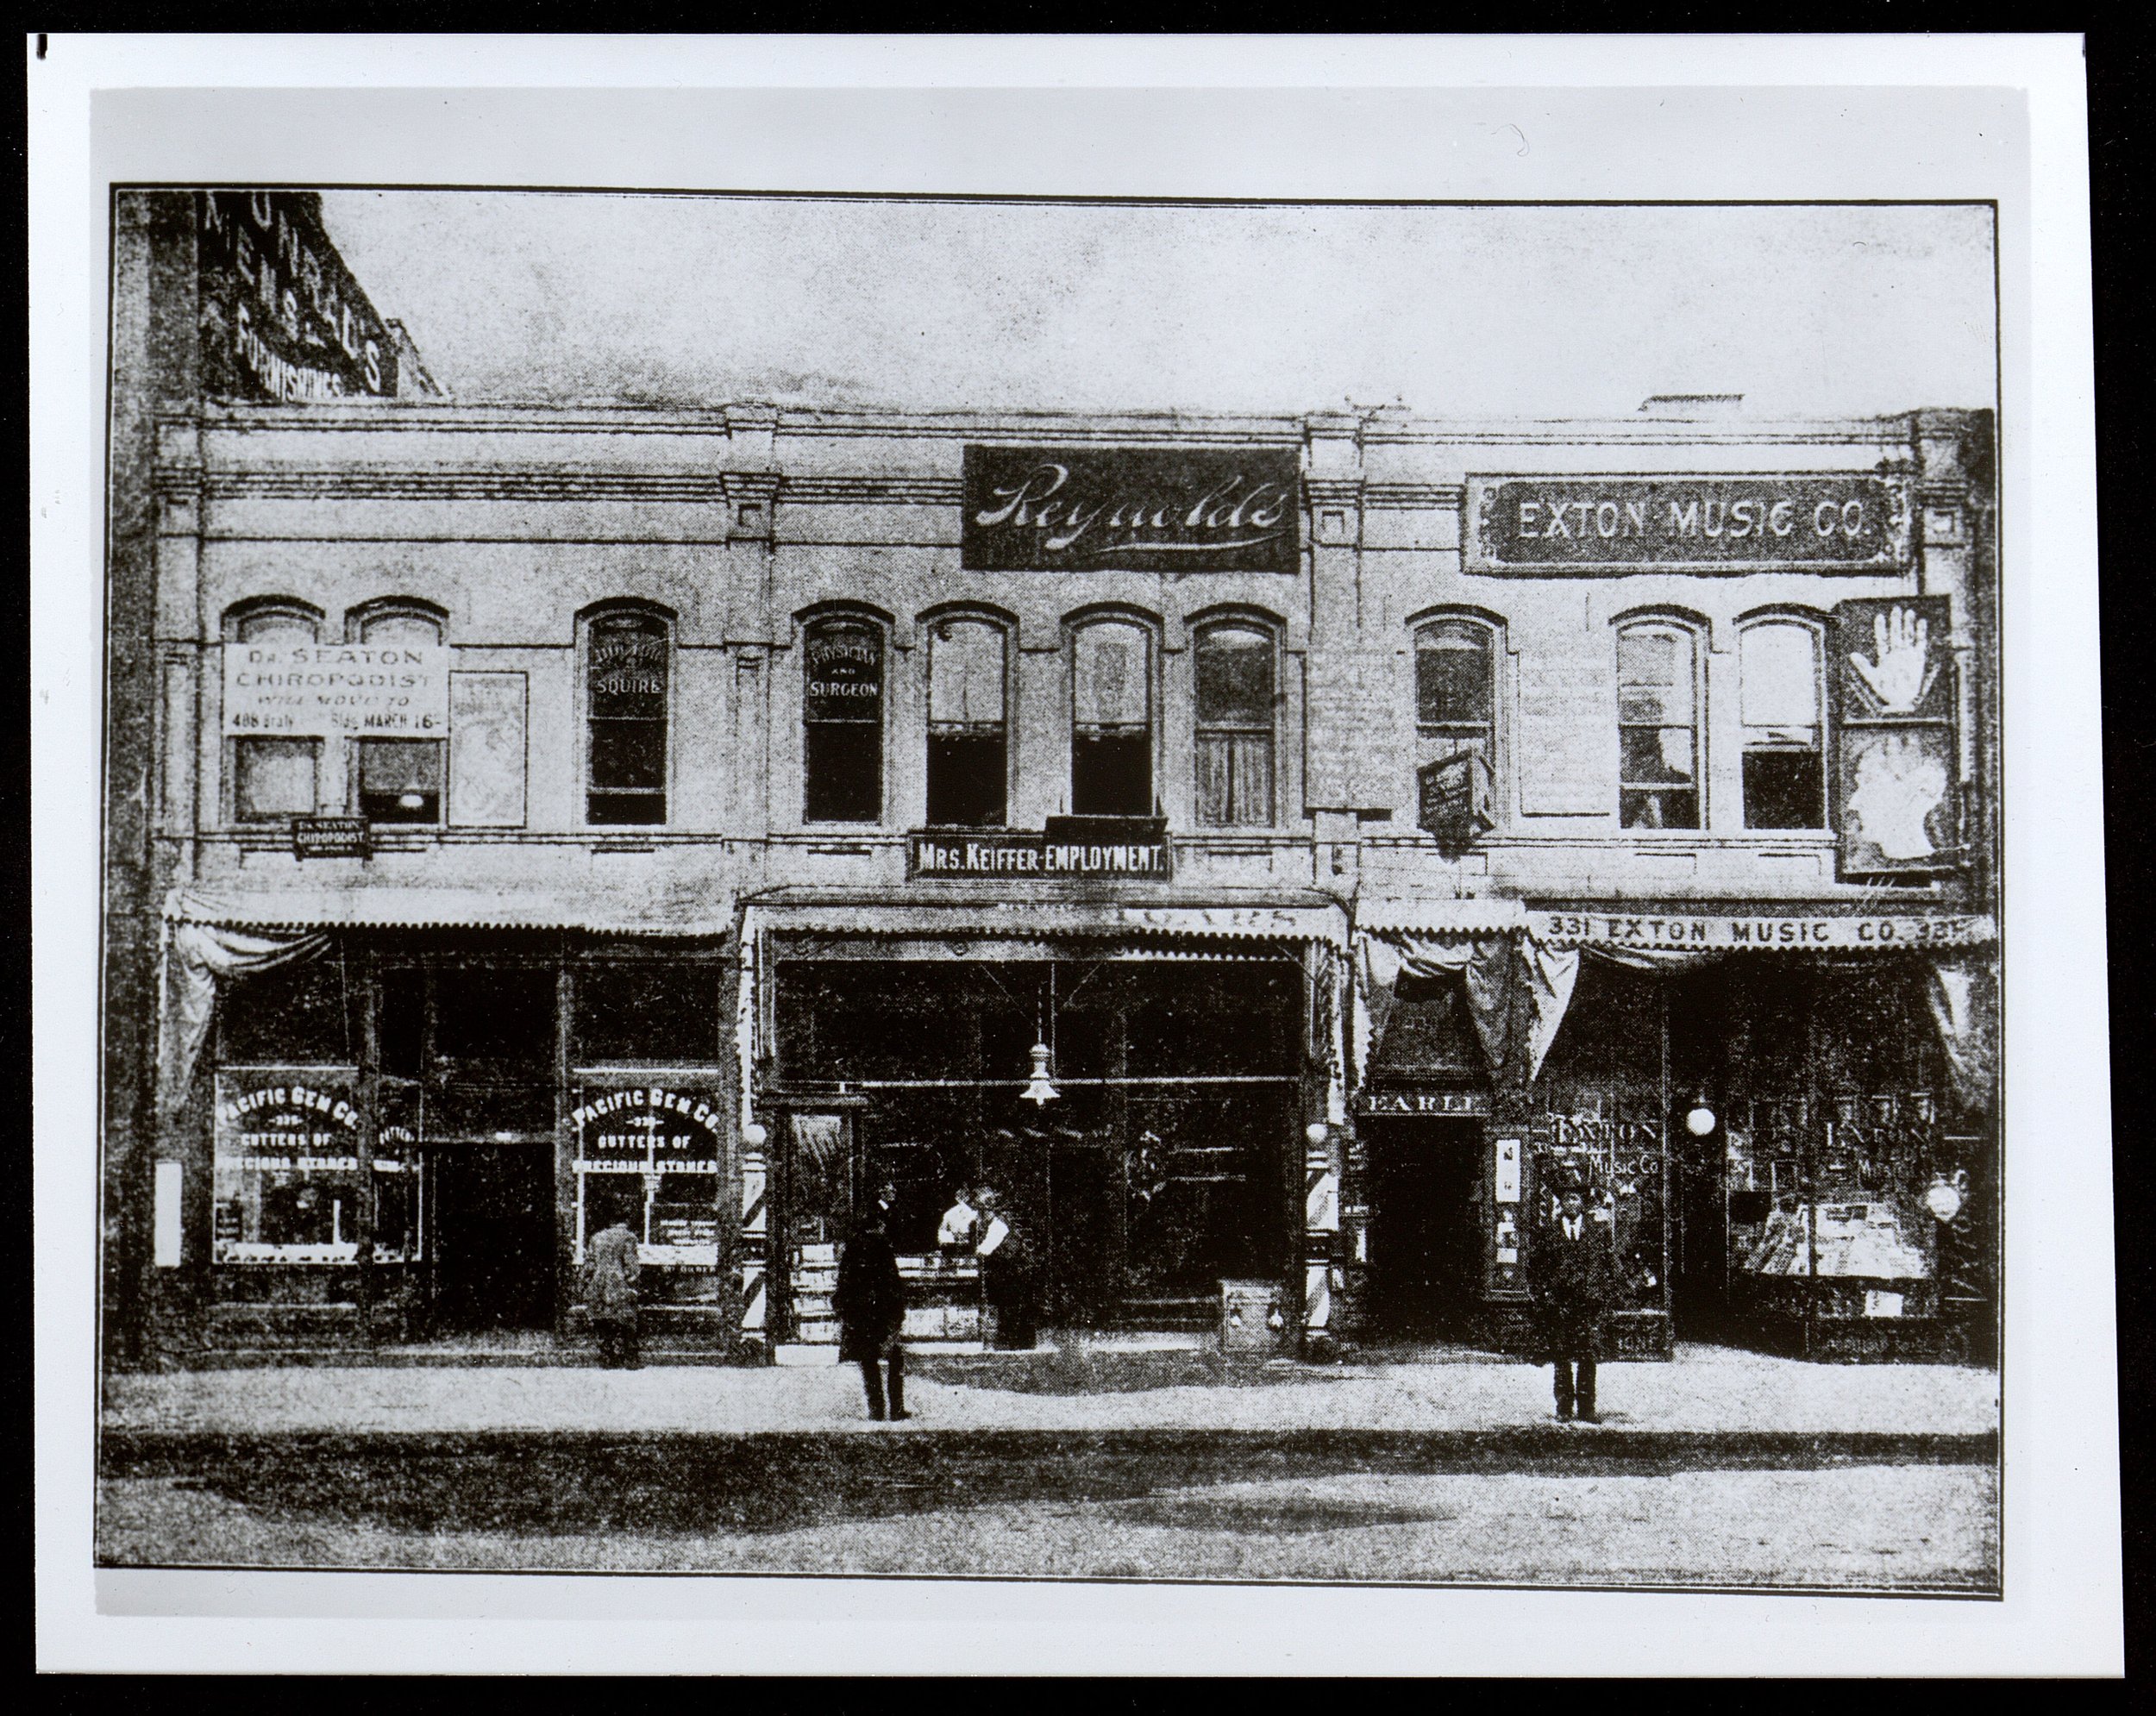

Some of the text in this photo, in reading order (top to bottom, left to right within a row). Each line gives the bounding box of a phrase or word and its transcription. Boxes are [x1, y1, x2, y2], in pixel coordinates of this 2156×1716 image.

[975, 463, 1288, 550] Reynolds
[1520, 501, 1645, 539] EXTON
[1670, 500, 1793, 538] MUSIC
[292, 647, 423, 665] SEATON
[235, 672, 431, 687] CHIROPODIST
[809, 680, 879, 698] SURGEON
[363, 711, 407, 730] MARCH
[919, 842, 965, 871] MRS.
[1549, 916, 1590, 936] 331
[1608, 917, 1708, 942] EXTON
[1730, 921, 1830, 943] MUSIC
[291, 1087, 331, 1112] GEM
[572, 1089, 644, 1128] PACIFIC
[650, 1088, 692, 1115] GEM
[241, 1132, 332, 1148] CUTTERS OF
[598, 1135, 691, 1149] CUTTERS OF
